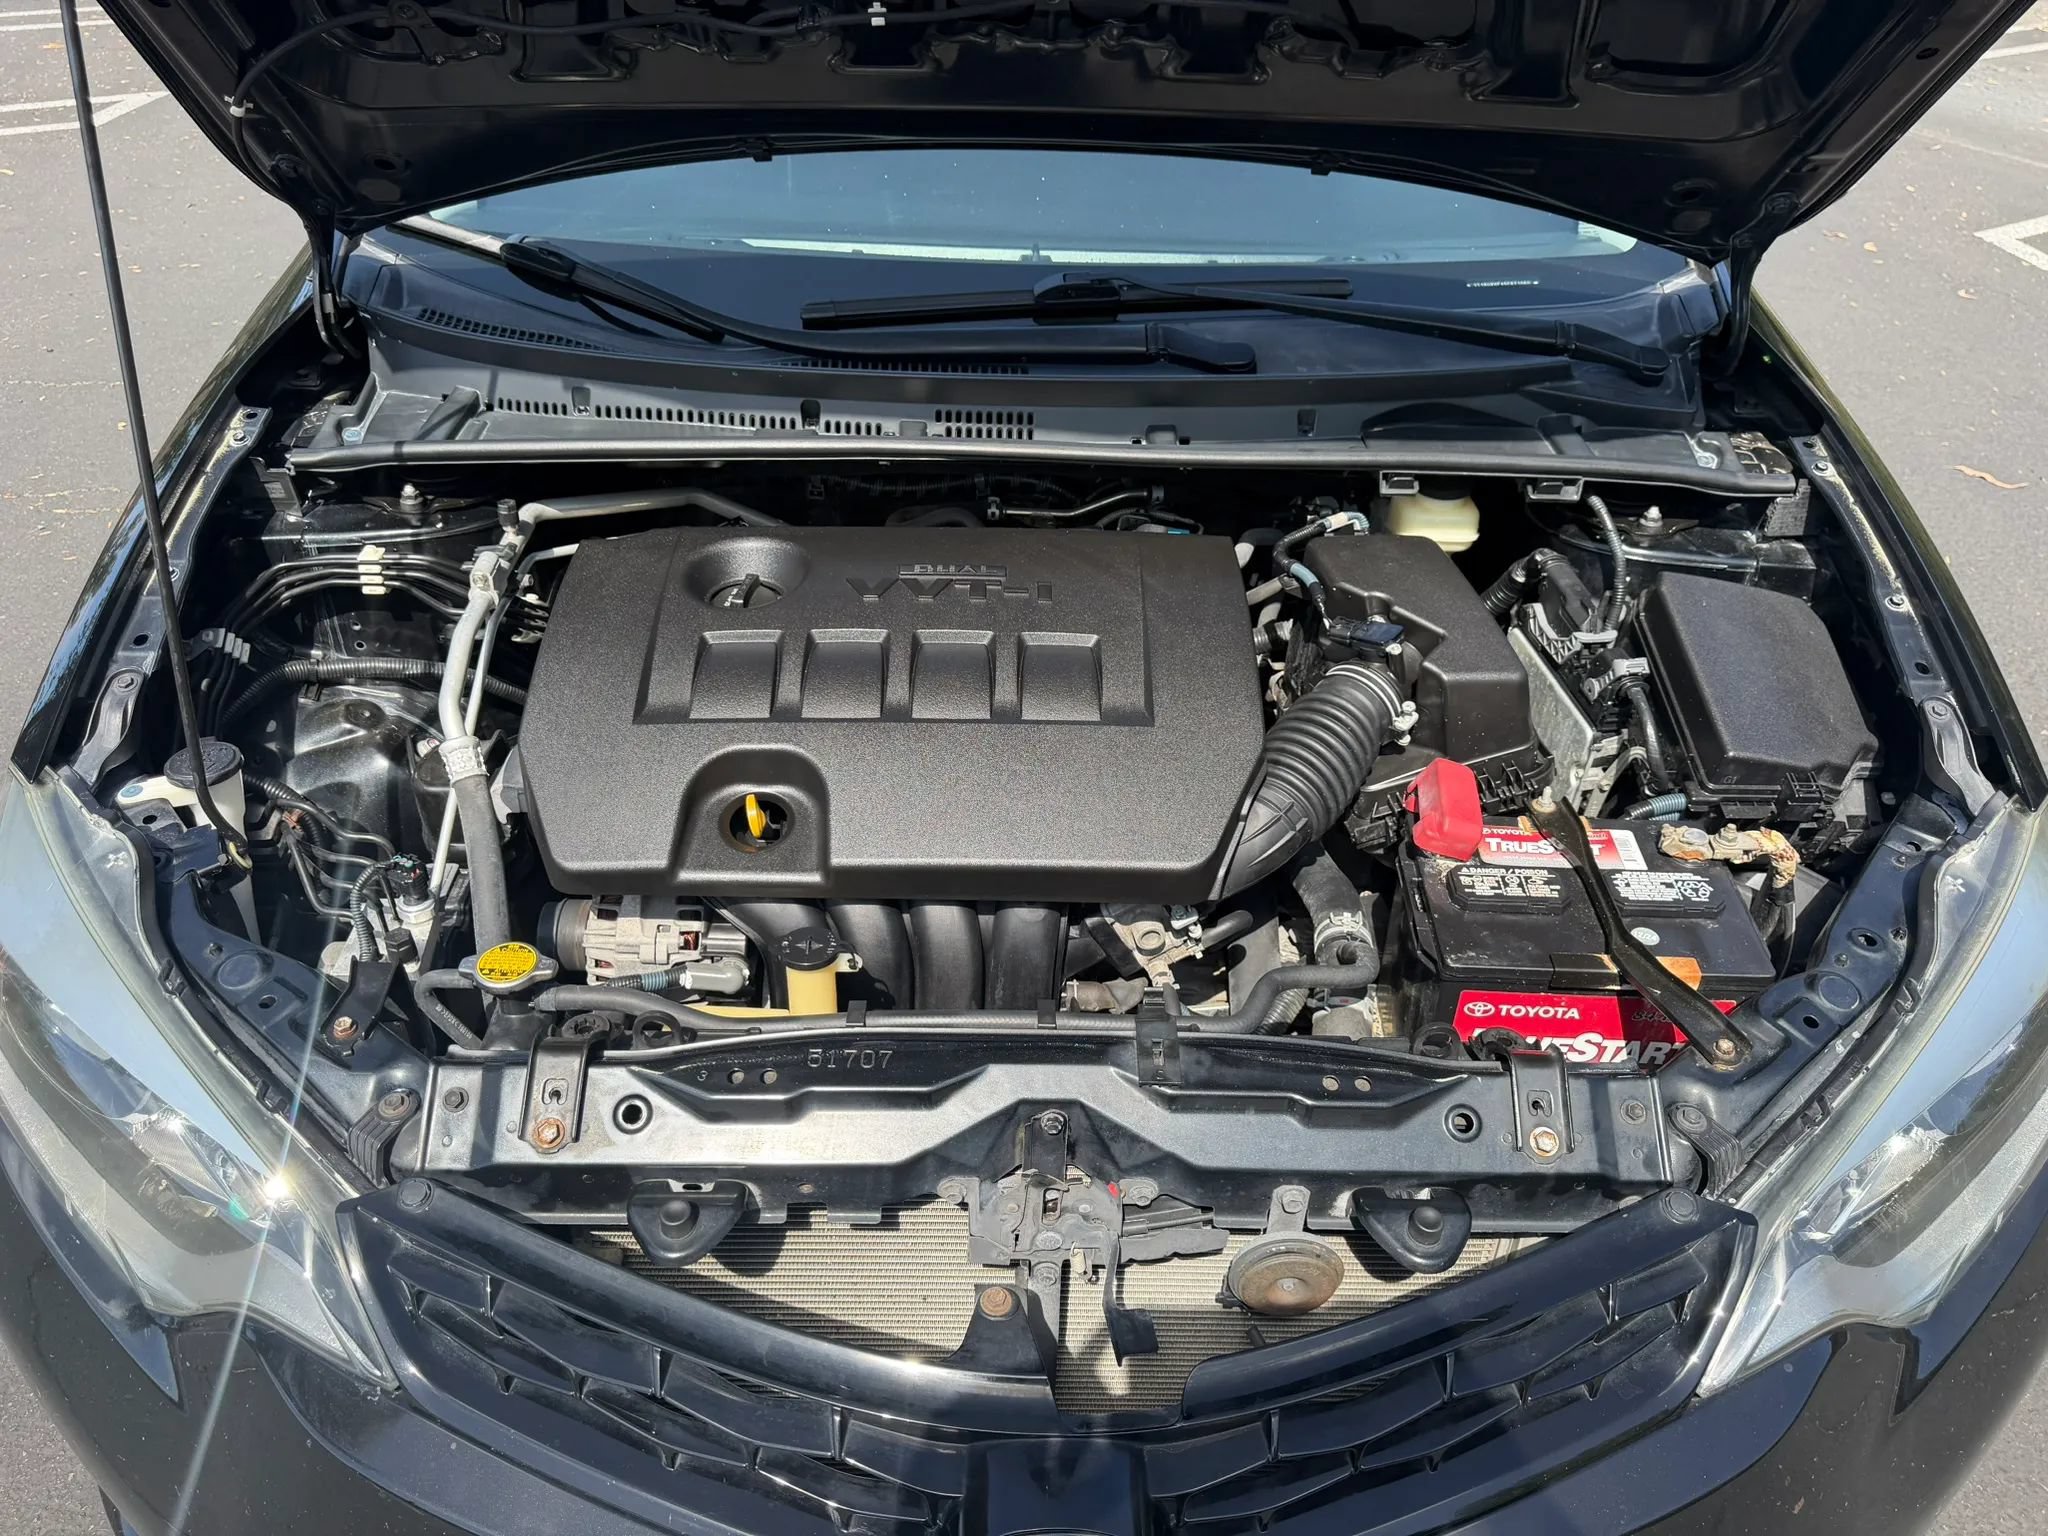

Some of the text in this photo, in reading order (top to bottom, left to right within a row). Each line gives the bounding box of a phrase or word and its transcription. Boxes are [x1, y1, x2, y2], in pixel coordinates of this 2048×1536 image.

[914, 564, 998, 574] DUAL
[1499, 1004, 1580, 1020] TOYOTA
[807, 1048, 893, 1068] 51707
